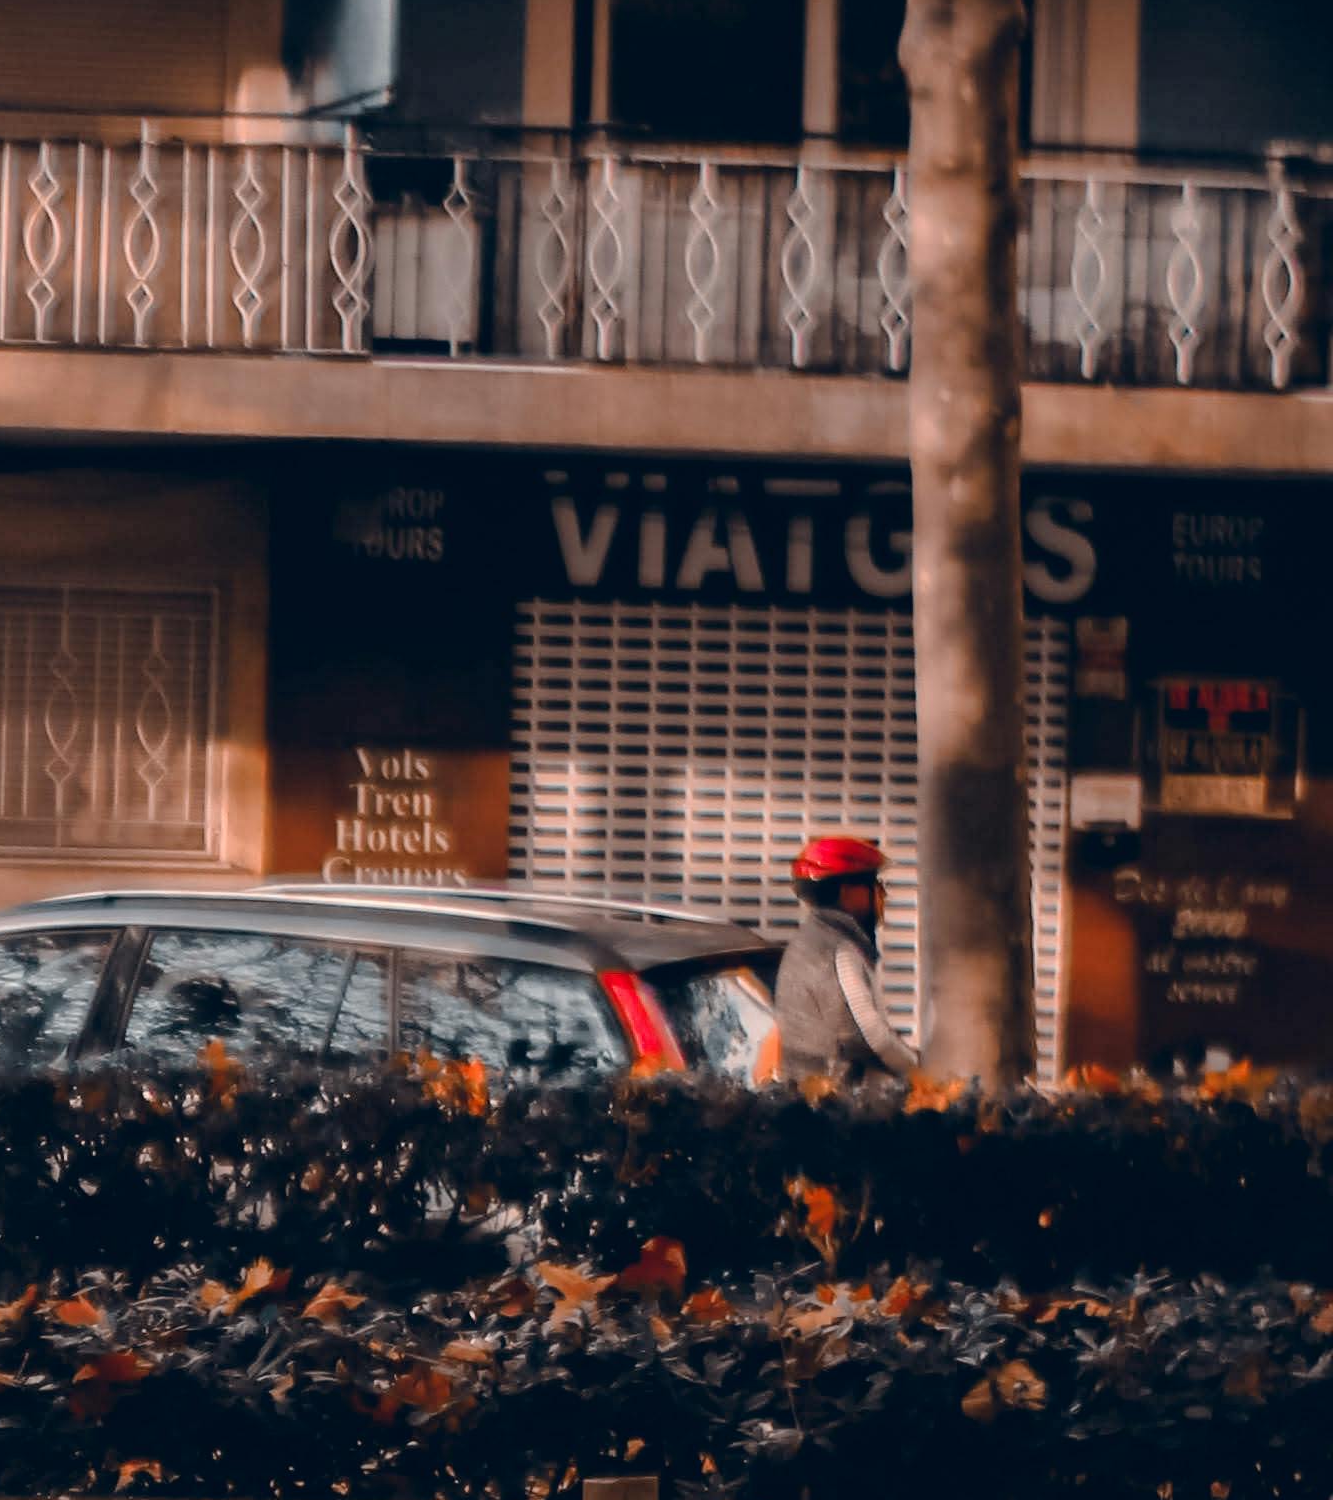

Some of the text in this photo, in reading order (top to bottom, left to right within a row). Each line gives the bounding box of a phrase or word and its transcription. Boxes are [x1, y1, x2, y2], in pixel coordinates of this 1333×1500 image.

[543, 469, 1098, 604] VIATGS
[355, 746, 431, 781] Vols
[348, 782, 433, 817] Tren
[335, 818, 451, 854] Hotels
